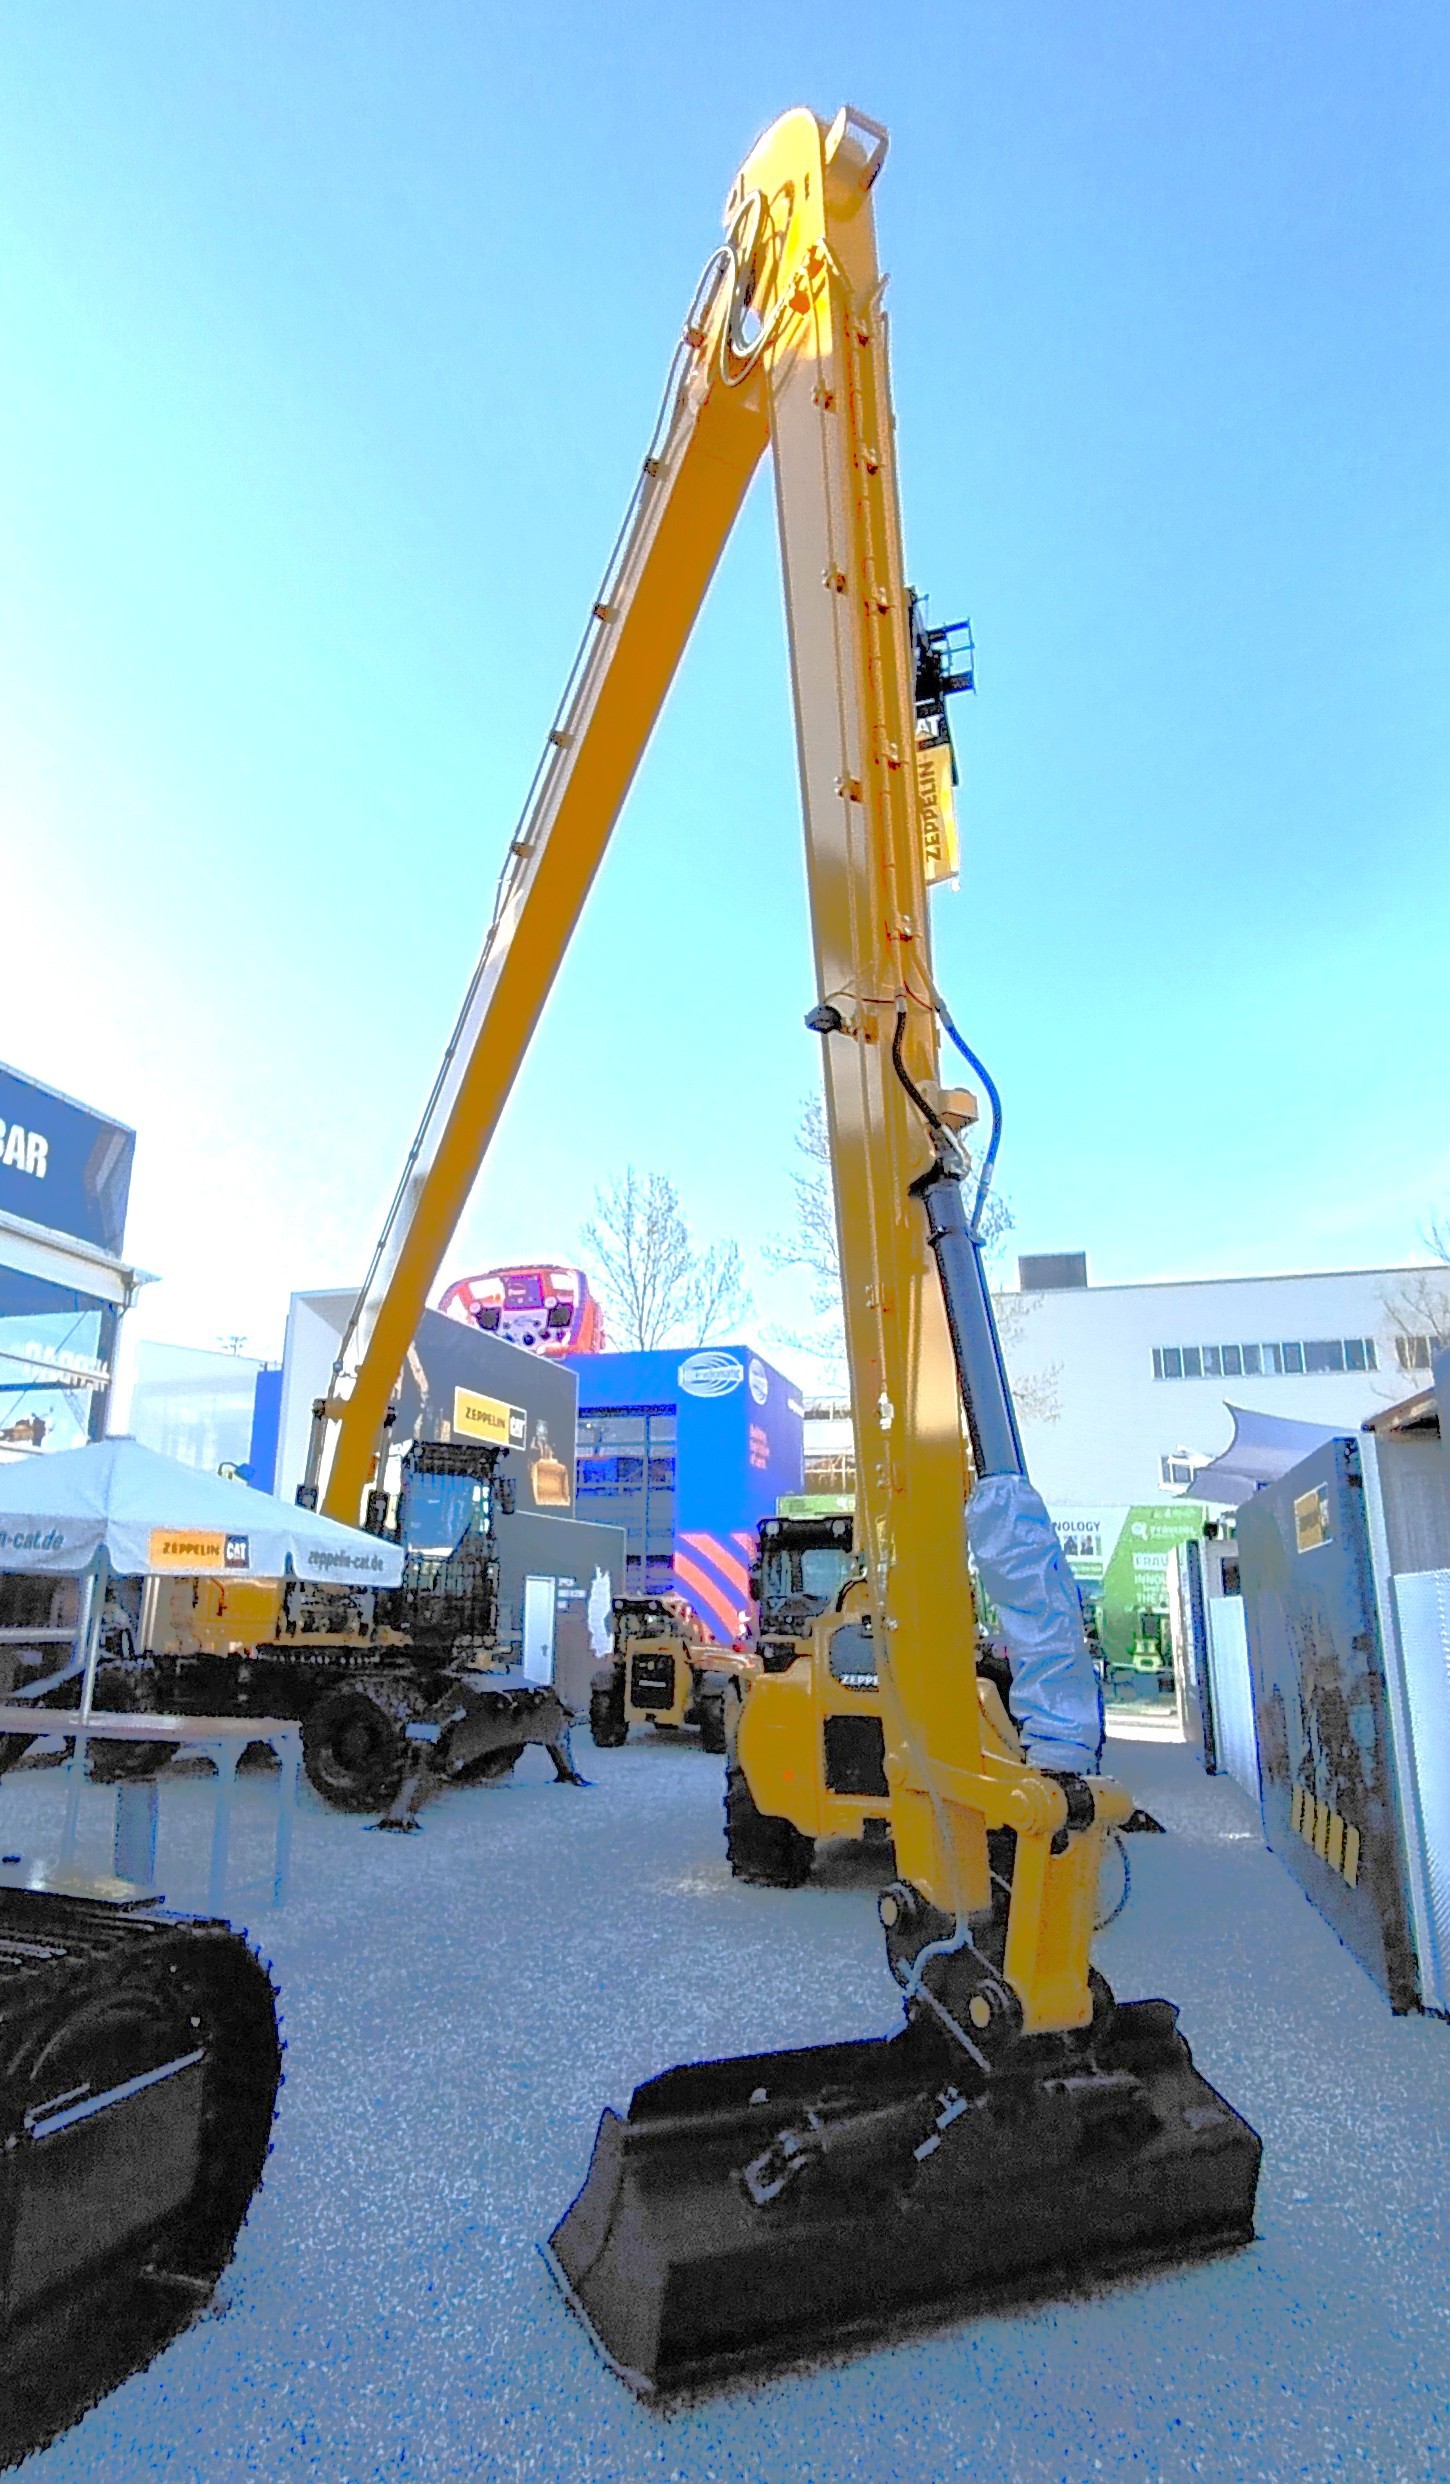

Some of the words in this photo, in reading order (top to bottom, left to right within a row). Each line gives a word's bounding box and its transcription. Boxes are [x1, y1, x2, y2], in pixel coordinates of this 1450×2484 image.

[919, 760, 942, 863] ZEPPELIN
[465, 1406, 506, 1429] ZEPPELIN
[163, 1542, 220, 1556] ZEPPELIN
[226, 1541, 246, 1561] CAT
[308, 1550, 384, 1571] zeppelin-cat.de
